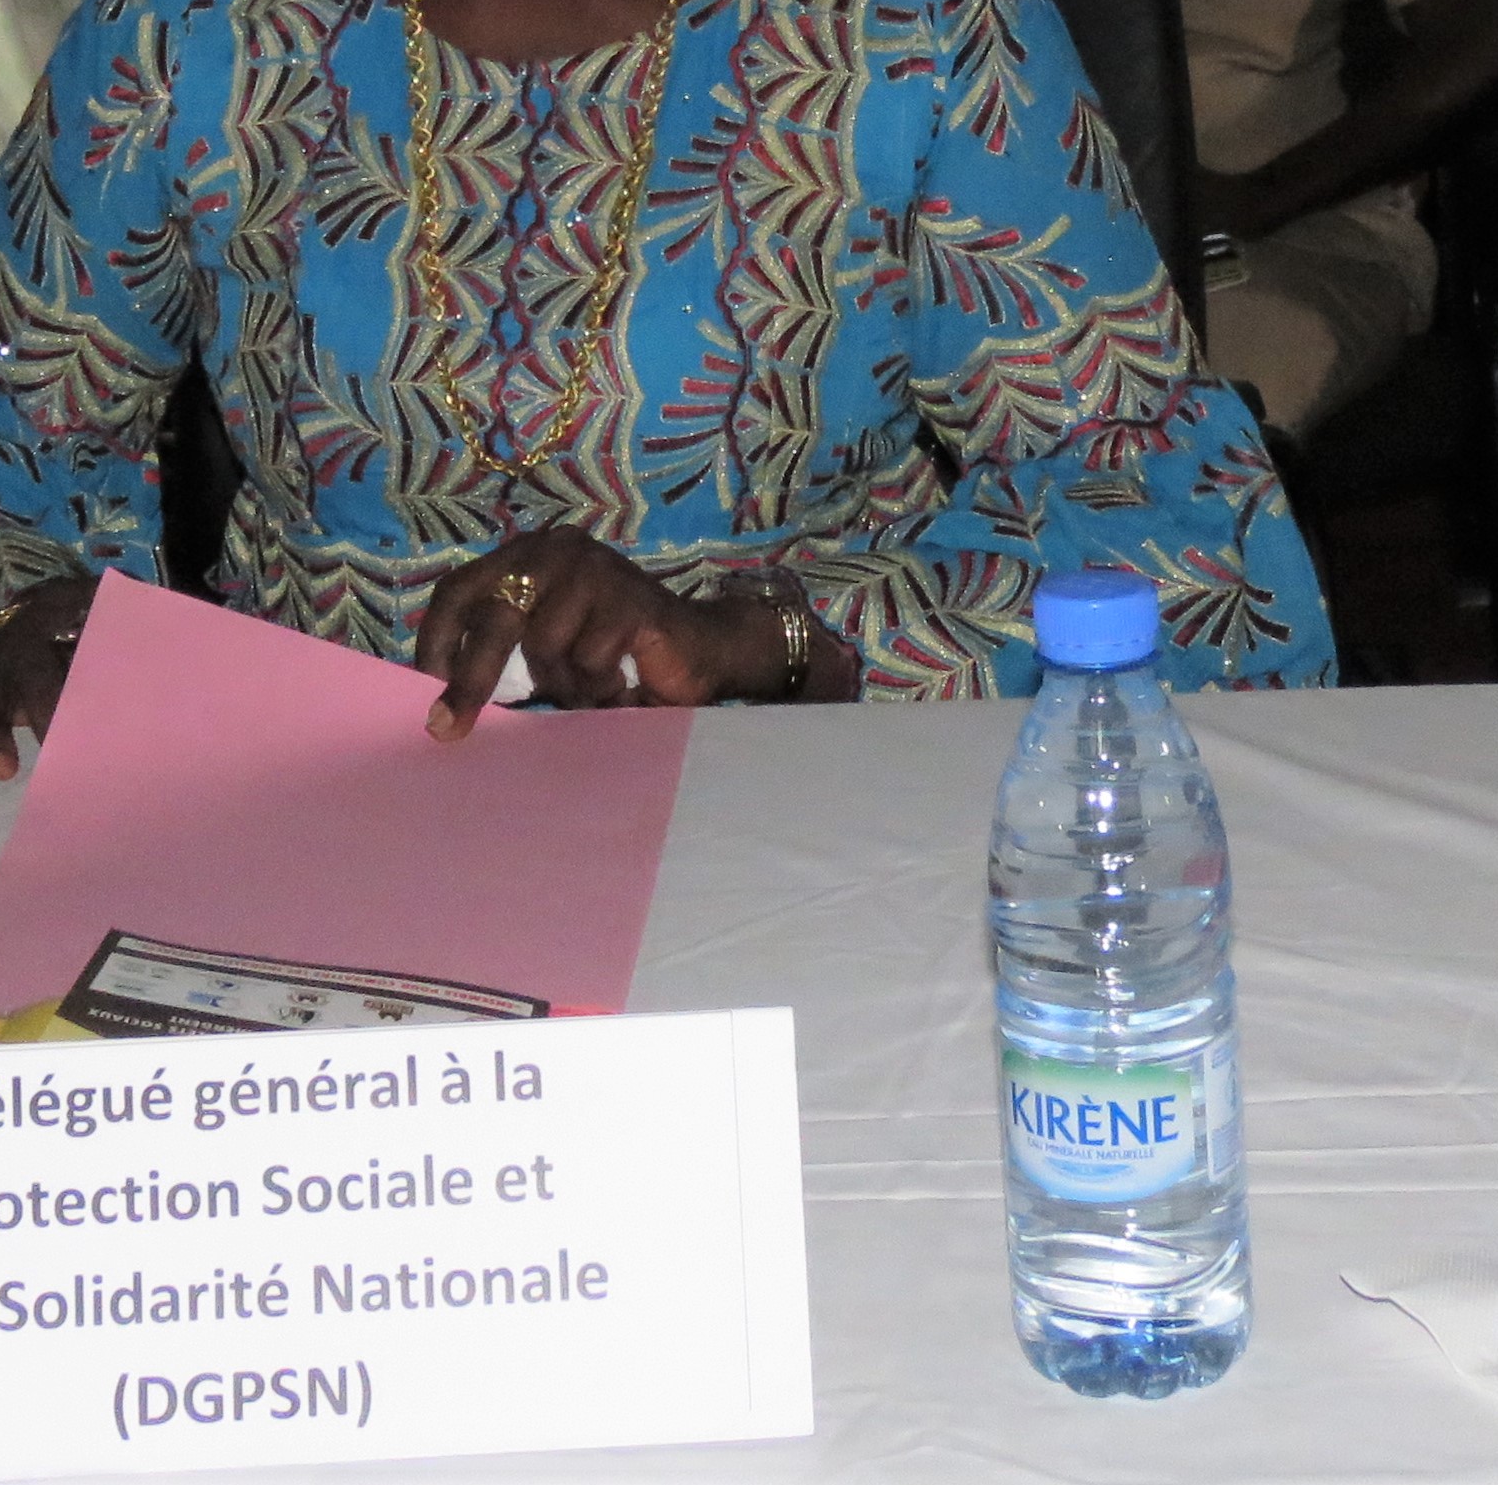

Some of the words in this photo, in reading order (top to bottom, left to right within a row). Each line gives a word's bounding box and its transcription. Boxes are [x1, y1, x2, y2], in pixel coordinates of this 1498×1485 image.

[87, 1007, 163, 1031] SOCIAUX
[193, 1054, 417, 1131] général
[441, 1052, 471, 1104] à
[494, 1050, 542, 1101] la
[1011, 1081, 1179, 1146] KIRÈNE
[262, 1154, 472, 1216] Sociale
[496, 1156, 553, 1201] et
[313, 1250, 607, 1314] Nationale
[113, 1361, 373, 1441] (DGPSN)
